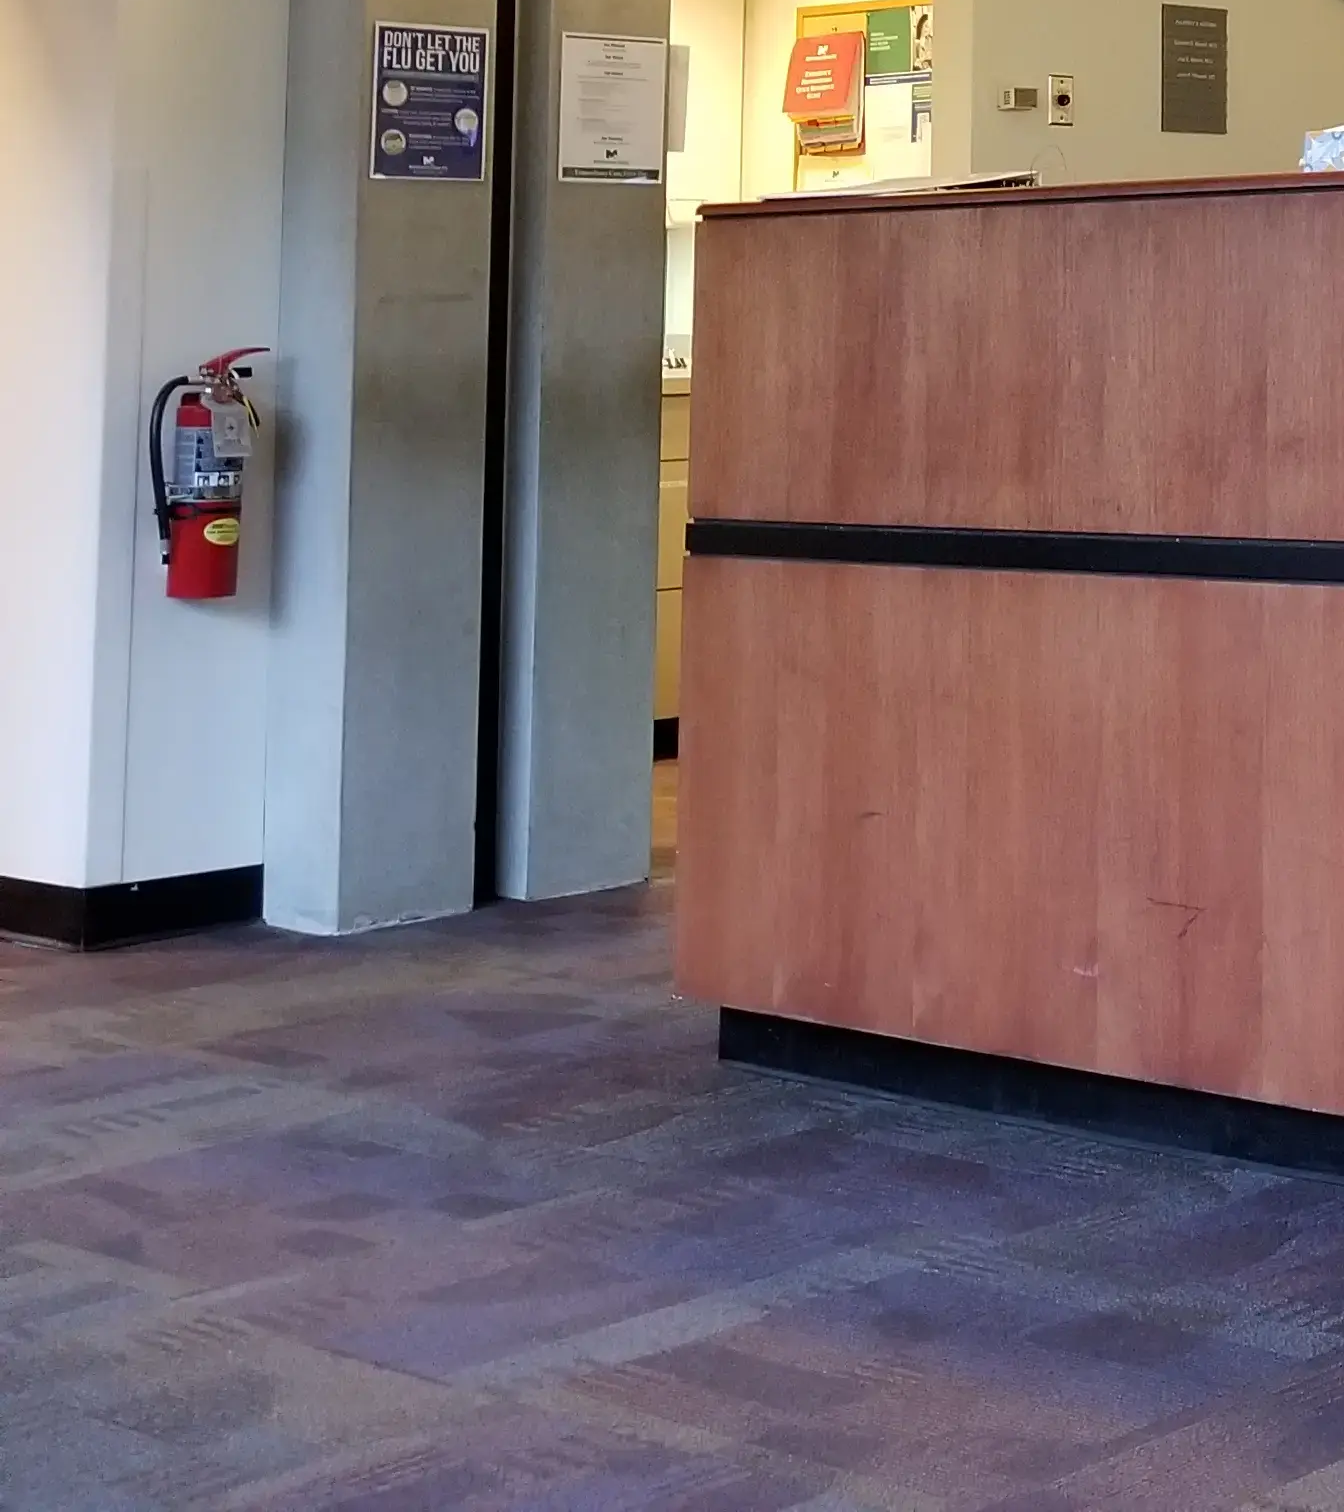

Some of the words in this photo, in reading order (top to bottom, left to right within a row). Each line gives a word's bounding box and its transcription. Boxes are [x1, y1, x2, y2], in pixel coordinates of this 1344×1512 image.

[384, 30, 425, 48] DON'T
[427, 33, 452, 51] LET
[454, 35, 480, 53] THE
[383, 47, 412, 69] FLU
[415, 49, 446, 72] GET
[449, 51, 480, 73] YOU
